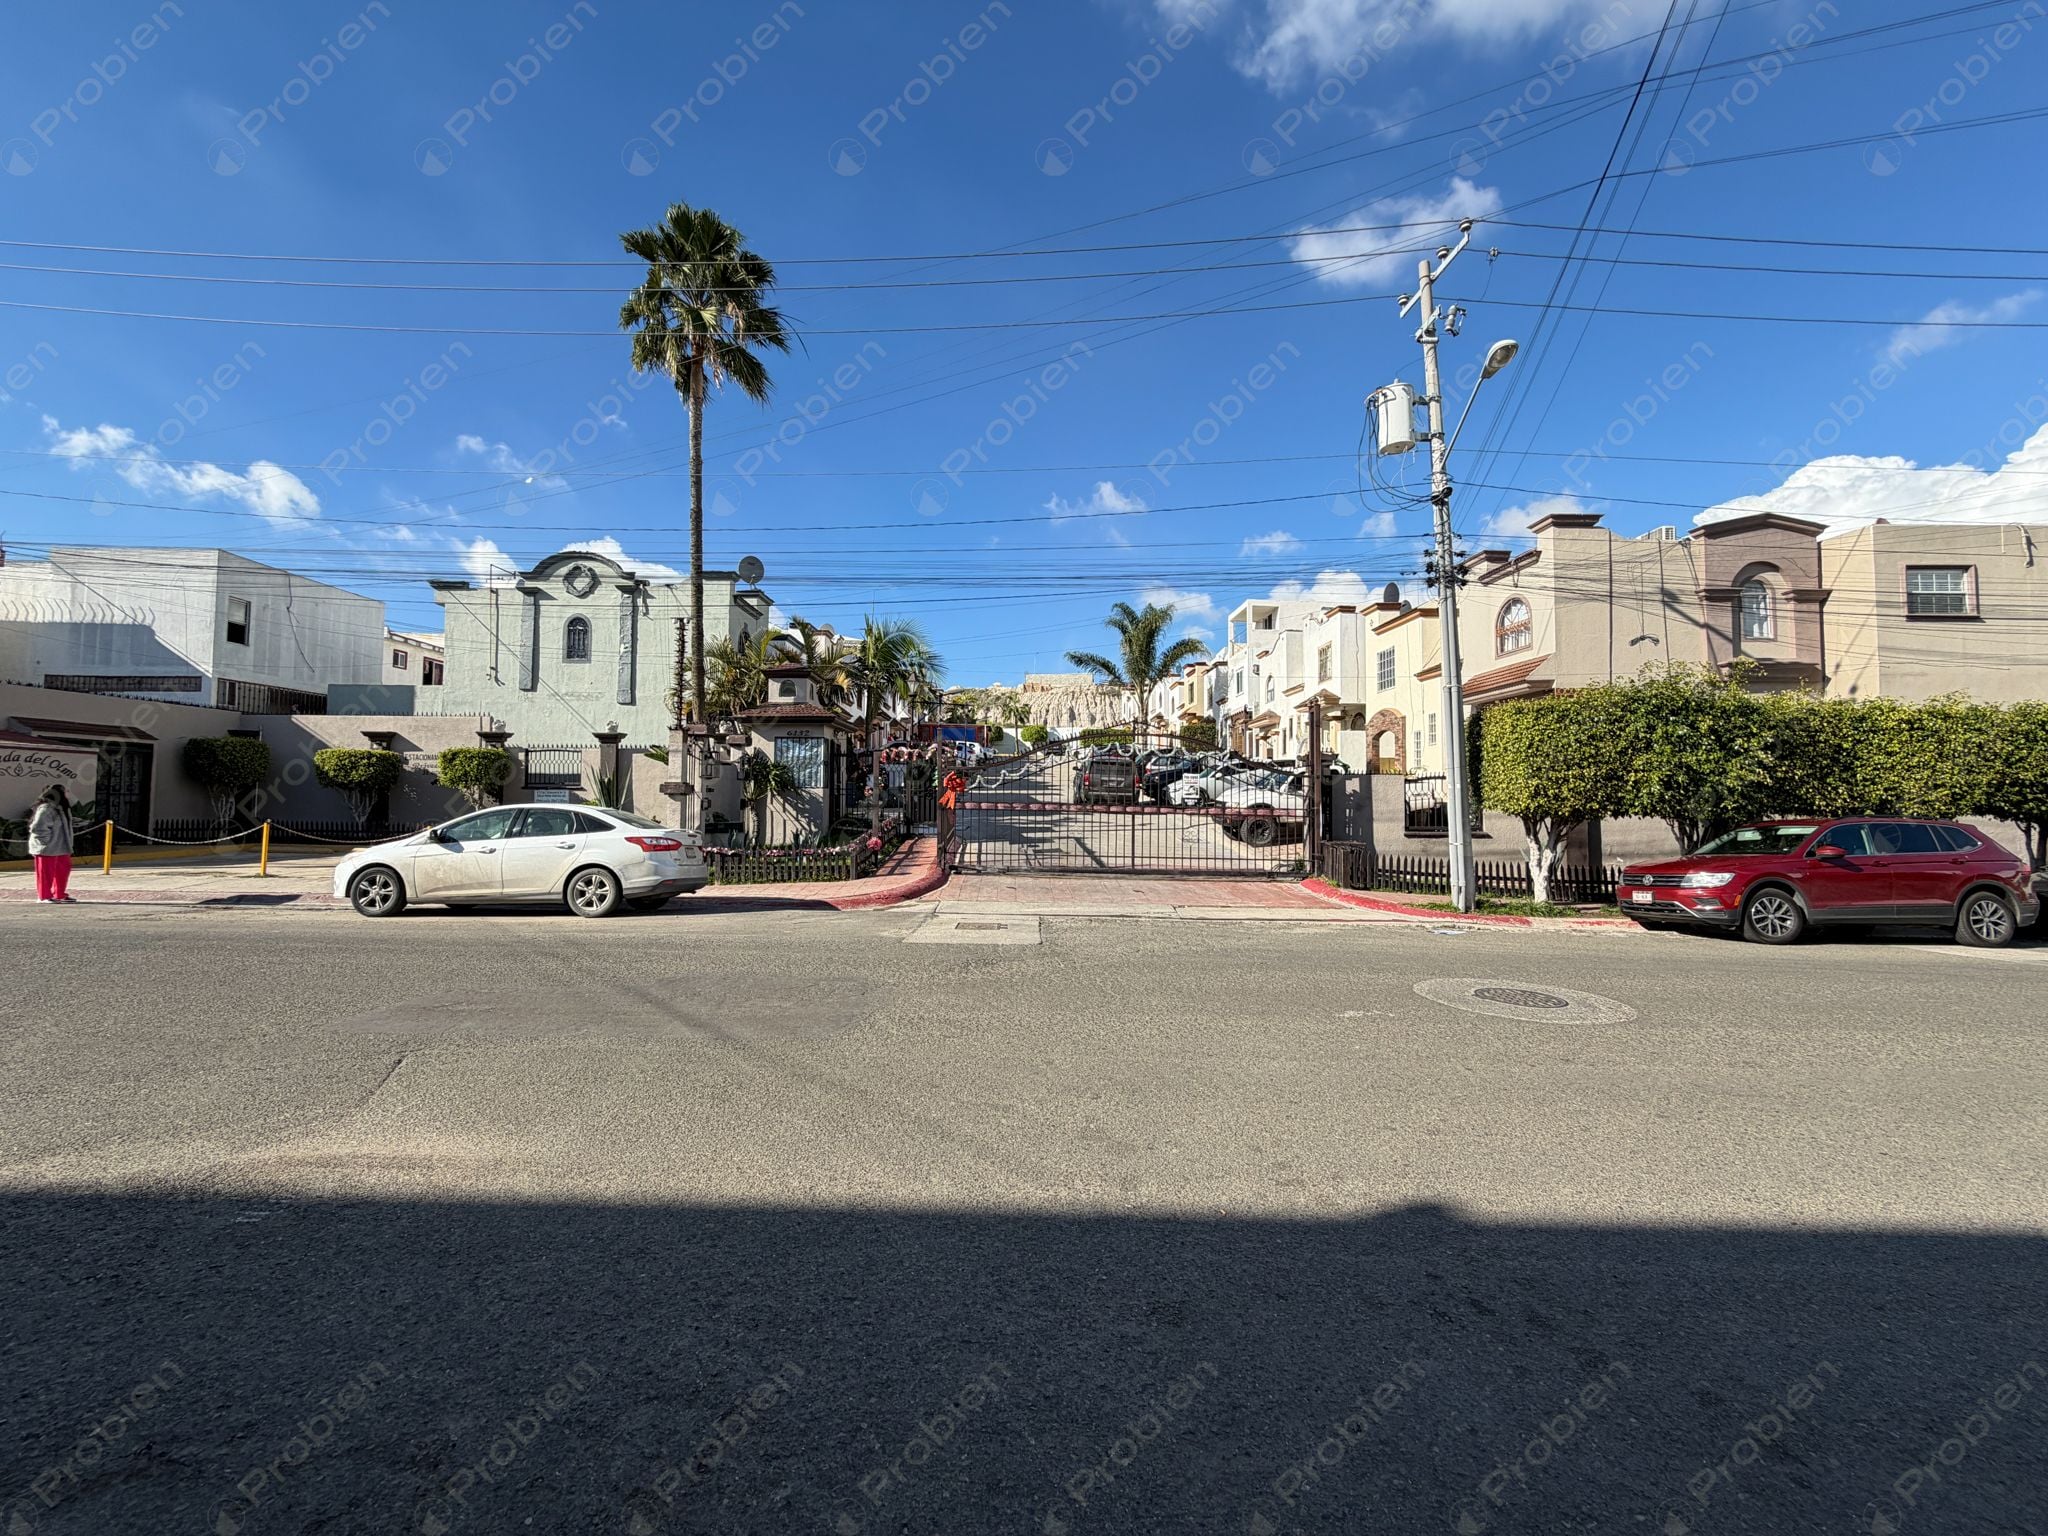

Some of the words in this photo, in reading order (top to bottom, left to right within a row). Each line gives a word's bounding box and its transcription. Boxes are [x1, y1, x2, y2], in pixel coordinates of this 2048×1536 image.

[0, 751, 21, 763] da
[24, 752, 51, 765] del
[49, 760, 78, 779] Olmo
